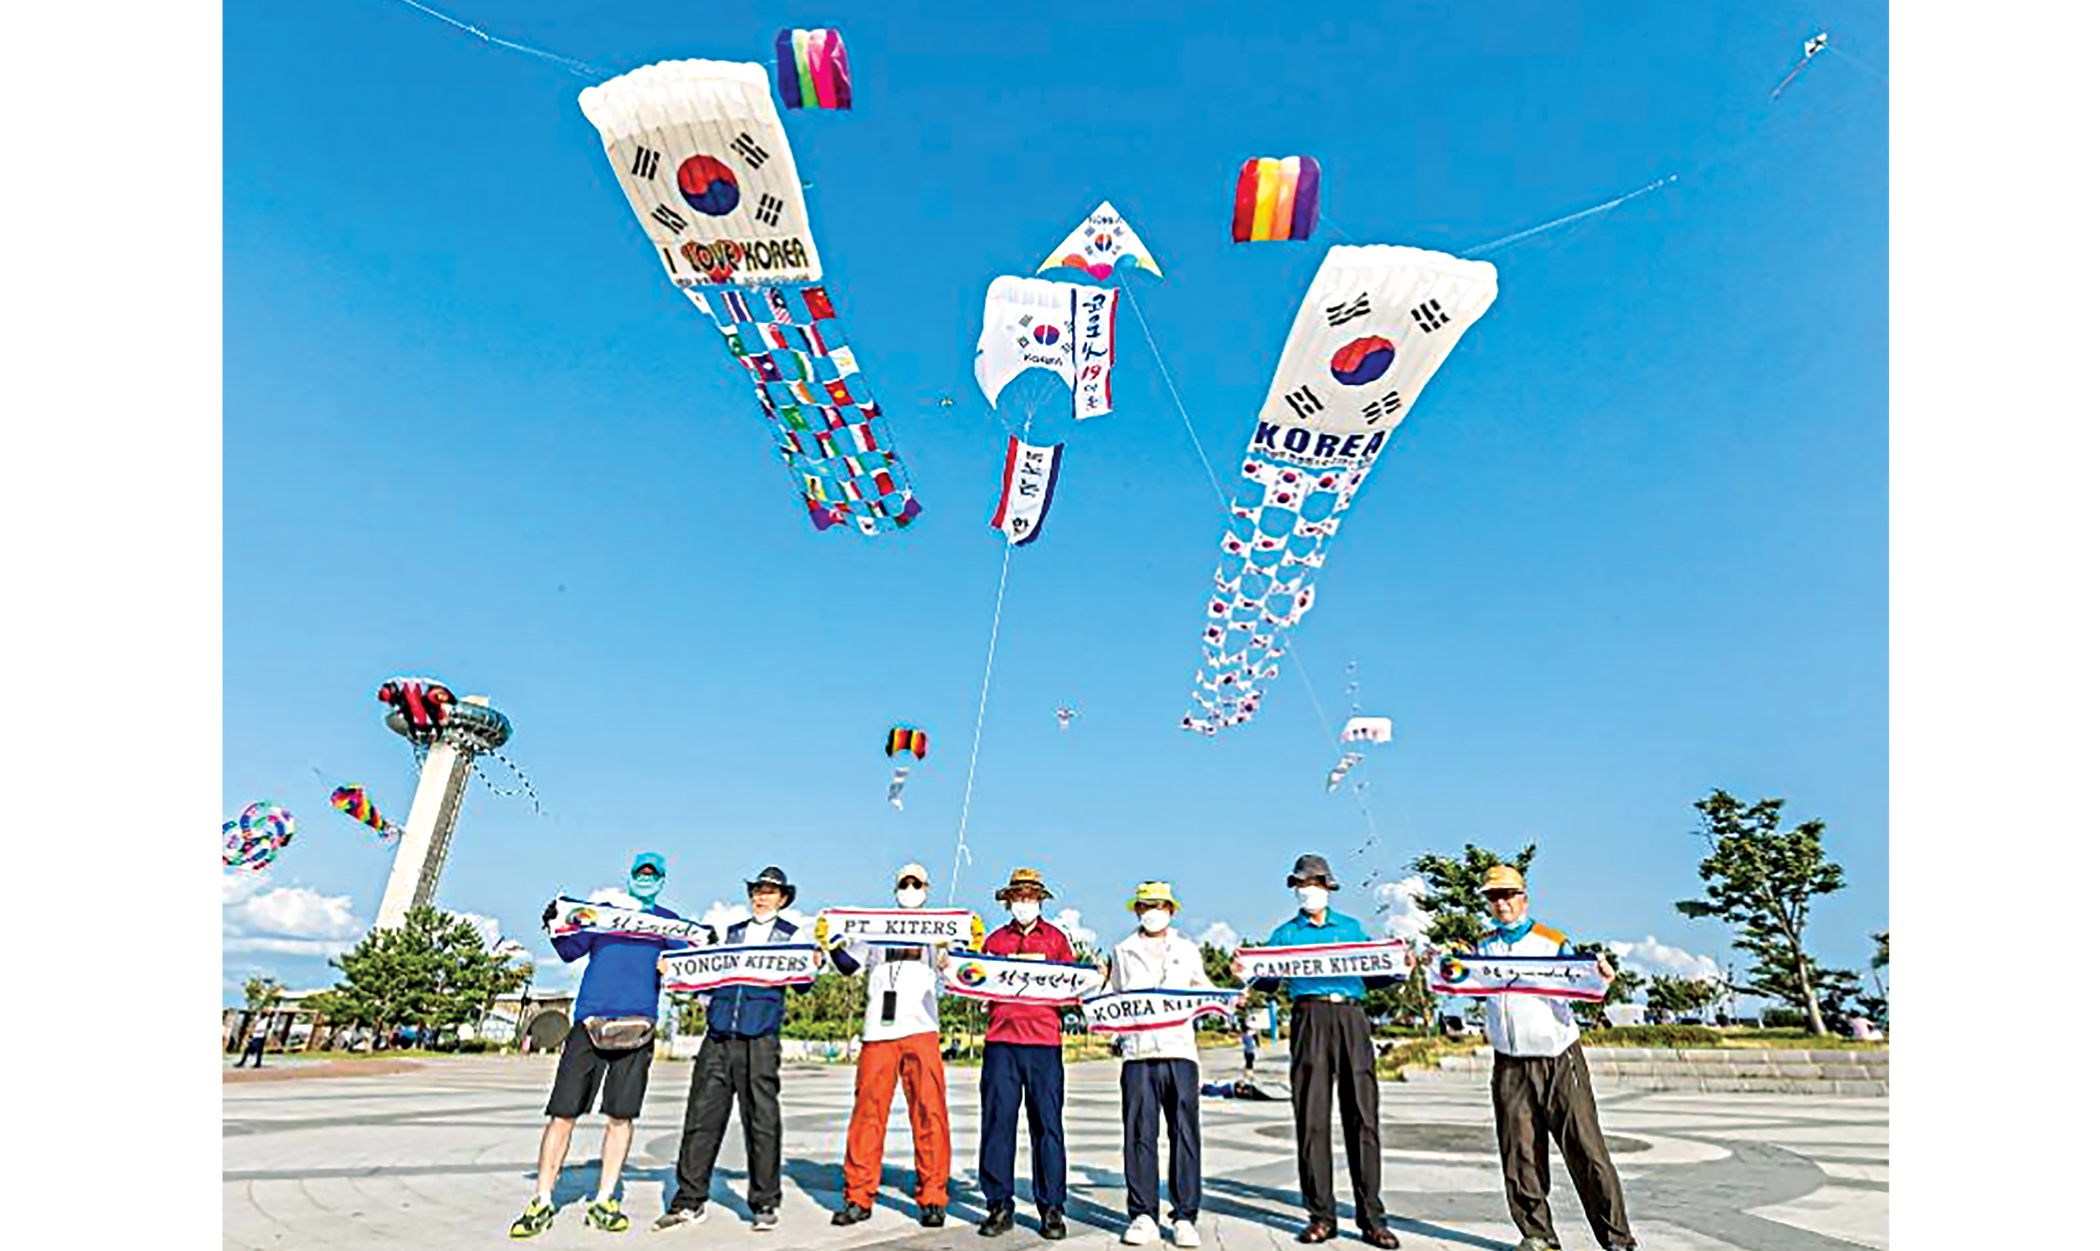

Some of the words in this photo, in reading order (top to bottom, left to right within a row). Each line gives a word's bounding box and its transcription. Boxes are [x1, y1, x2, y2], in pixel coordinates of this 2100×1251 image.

[662, 248, 678, 274] I
[686, 242, 740, 272] LOVE
[739, 237, 810, 272] KOREA
[1254, 421, 1386, 458] KOREA
[843, 919, 871, 935] PT
[884, 919, 958, 937] KITERS
[744, 954, 810, 973] KITERS
[1253, 958, 1325, 978] CAMPER
[1330, 953, 1393, 974] KITERS
[1093, 999, 1156, 1022] KOREA
